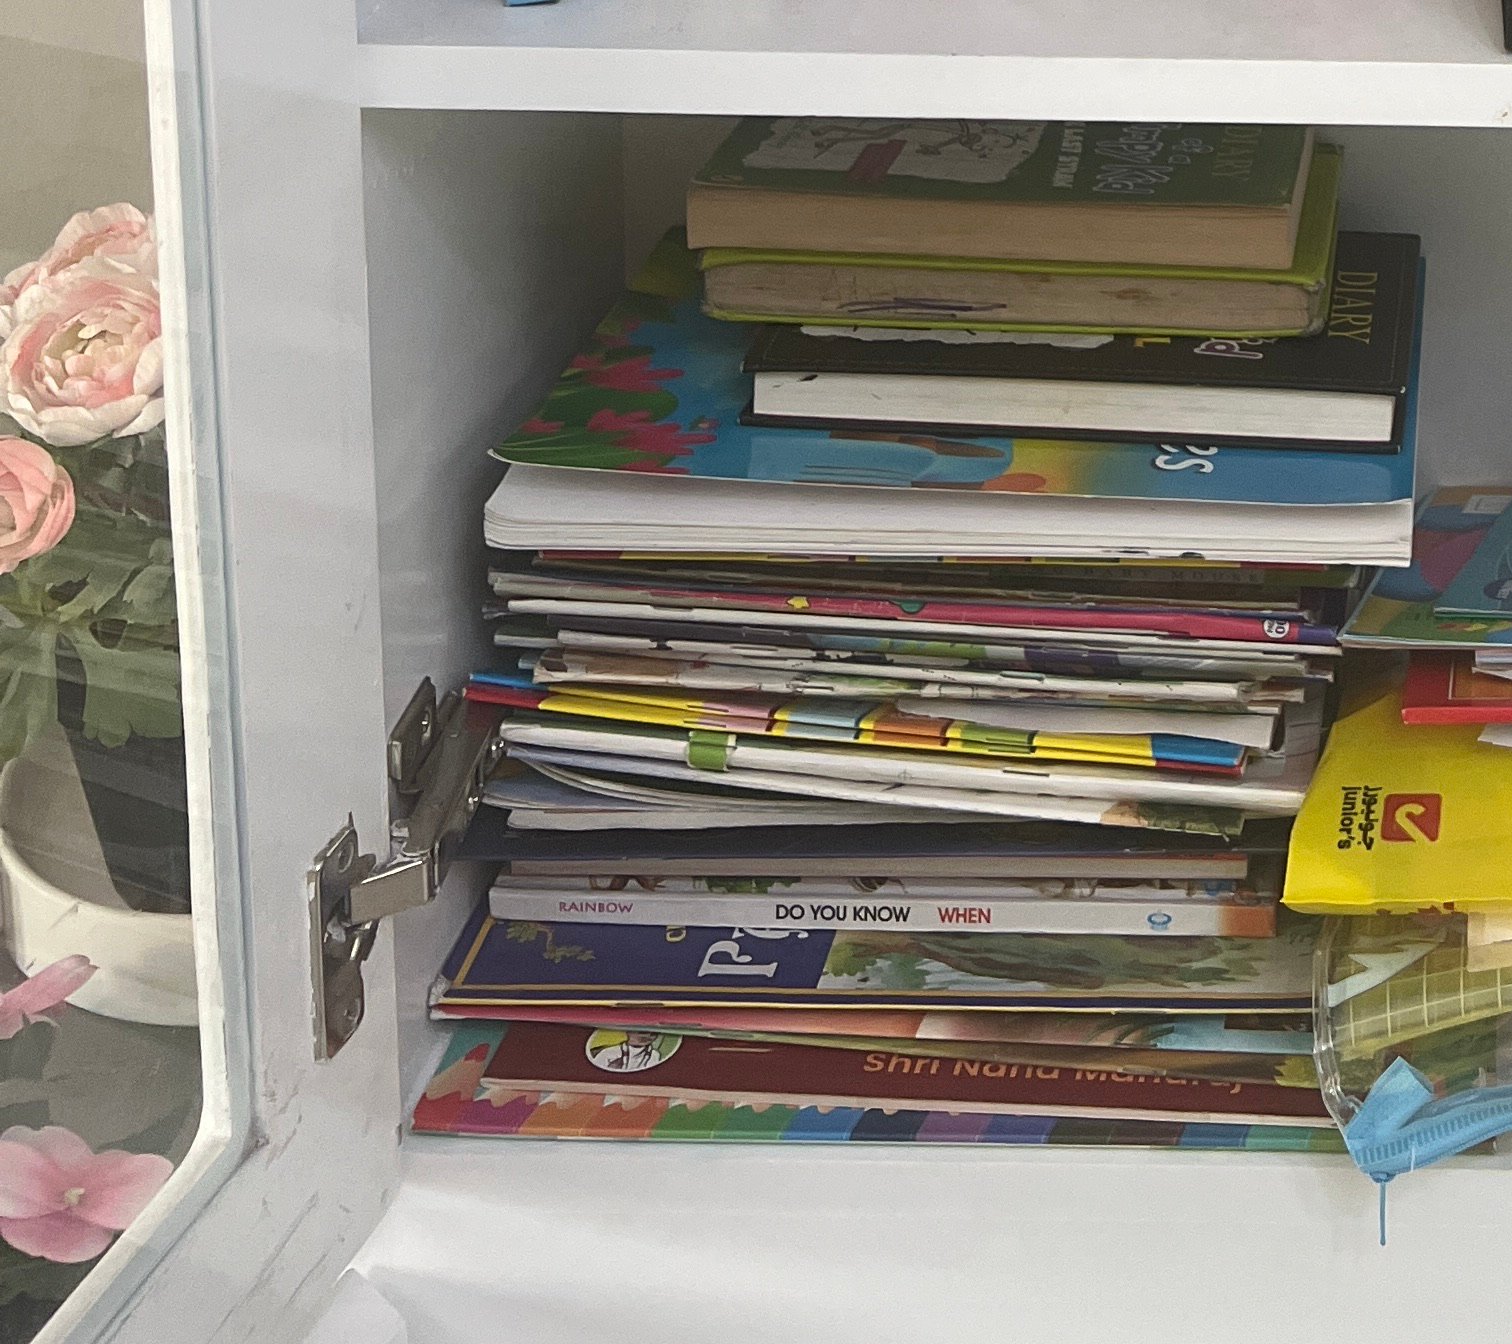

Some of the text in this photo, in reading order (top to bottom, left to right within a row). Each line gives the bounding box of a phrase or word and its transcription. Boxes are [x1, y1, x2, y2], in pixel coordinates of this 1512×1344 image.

[1328, 271, 1378, 344] DIARY
[1338, 785, 1362, 850] junior's
[559, 900, 992, 924] RAINBOW DO YOU KNOW WHEN
